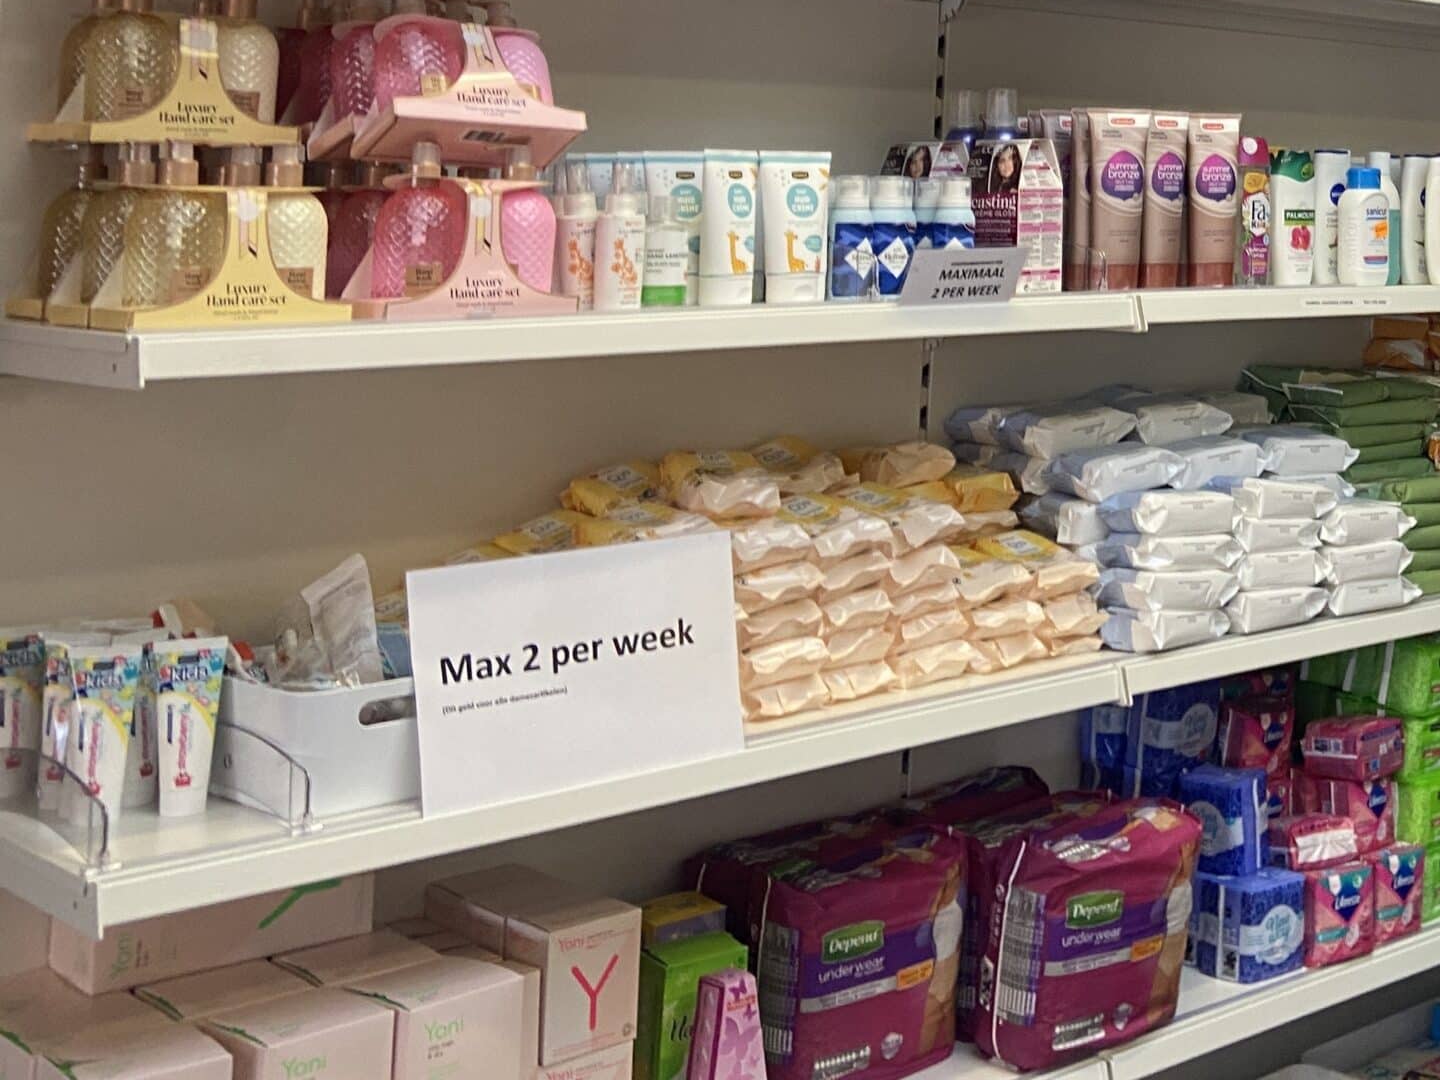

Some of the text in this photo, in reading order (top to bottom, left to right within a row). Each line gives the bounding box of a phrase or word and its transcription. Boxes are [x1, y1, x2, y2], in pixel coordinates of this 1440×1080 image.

[473, 85, 511, 97] Luxury
[457, 92, 526, 108] Hand care set
[177, 101, 218, 114] Luxury
[159, 112, 234, 125] Hand care set
[1108, 162, 1140, 172] summer
[1203, 165, 1232, 174] summer
[1108, 169, 1141, 181] bronze
[1157, 170, 1184, 181] bronze
[1202, 172, 1232, 183] bronze
[971, 193, 1018, 215] casting
[1251, 199, 1267, 220] Fa
[939, 267, 1006, 281] MAXIMAAL
[226, 282, 269, 295] Luxury
[466, 277, 504, 288] Luxury
[450, 287, 520, 299] Hand care set
[930, 285, 1002, 299] 2 PER WEEK
[207, 295, 287, 307] Hand care set
[440, 617, 695, 686] Max 2 per week
[171, 664, 209, 683] kids
[1072, 897, 1120, 920] Depend
[829, 928, 879, 954] Depend
[1061, 927, 1122, 948] underwear
[818, 956, 885, 984] underwear
